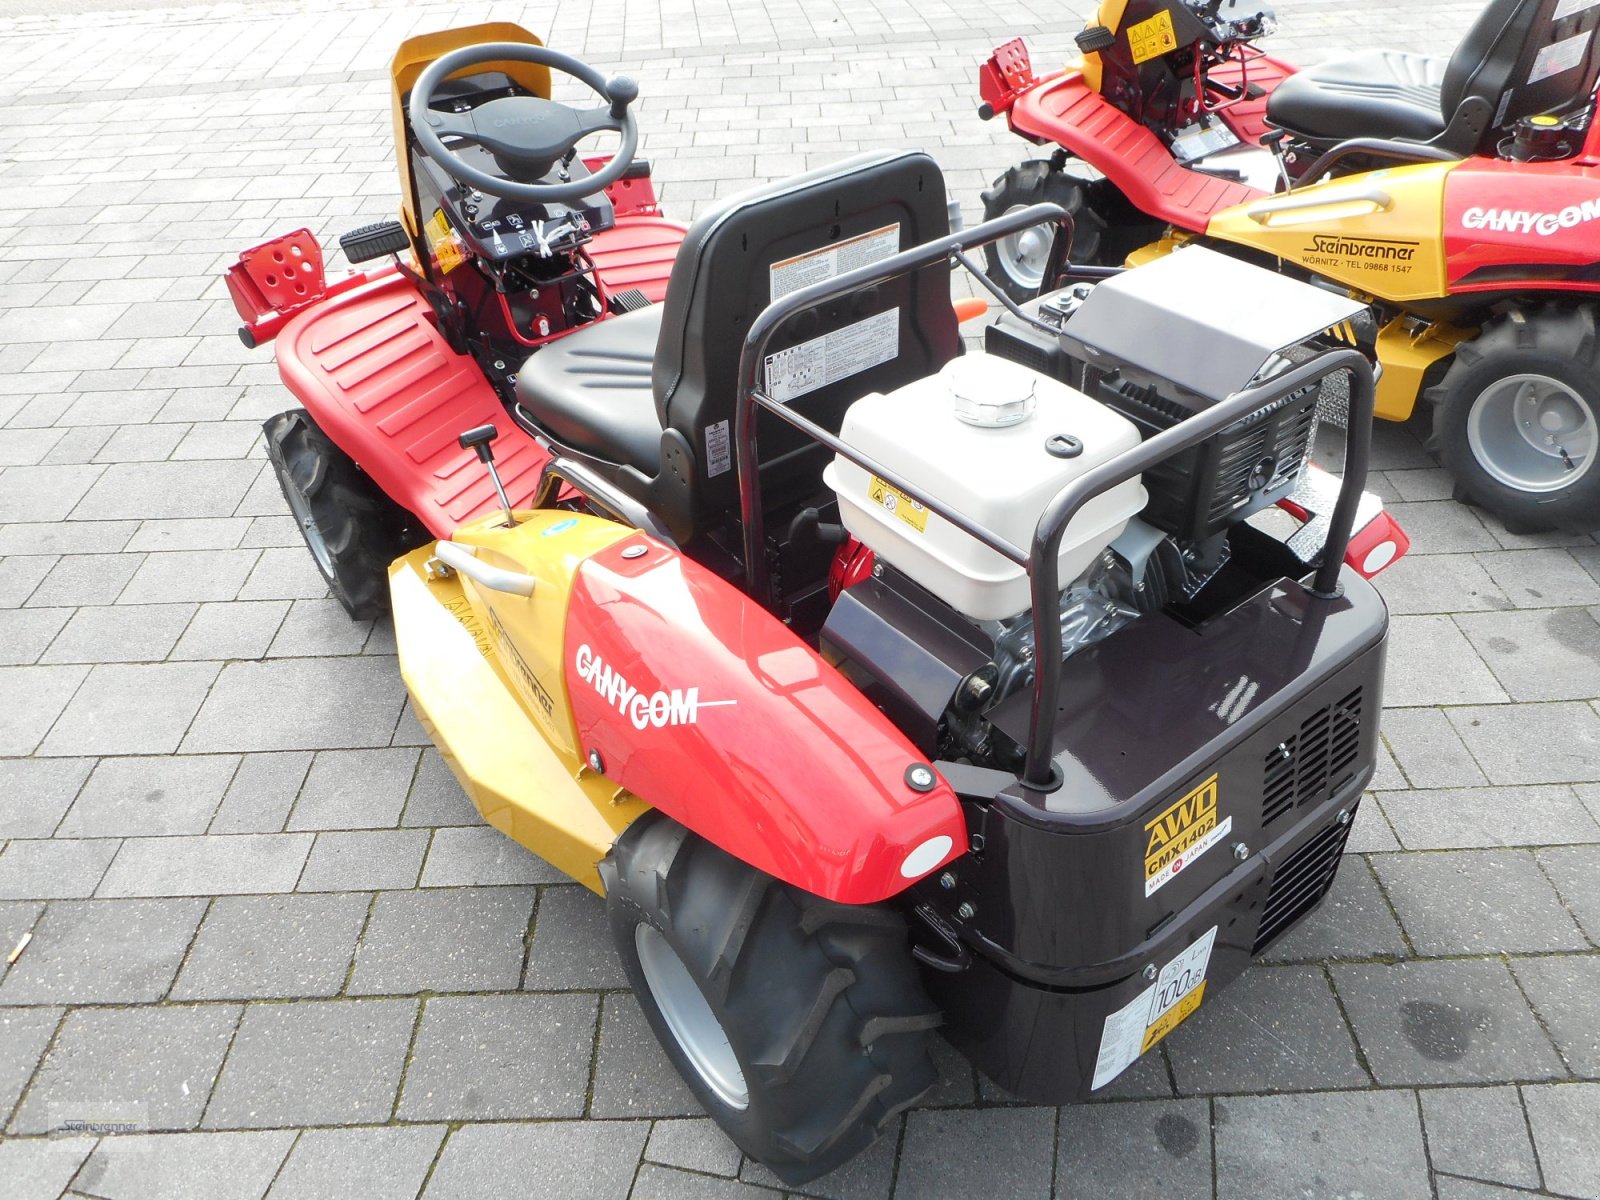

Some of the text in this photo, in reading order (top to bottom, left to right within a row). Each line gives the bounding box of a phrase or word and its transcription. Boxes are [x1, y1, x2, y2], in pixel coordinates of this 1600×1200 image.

[1302, 255, 1412, 274] WÖRNITZ TEL 09868 1547
[1303, 234, 1419, 260] Steinbrenner
[576, 644, 699, 730] CANYCOM
[1145, 781, 1218, 858] AWD
[1148, 817, 1215, 875] CMX1402
[1149, 870, 1170, 889] MADE
[1185, 839, 1208, 862] JAPAN
